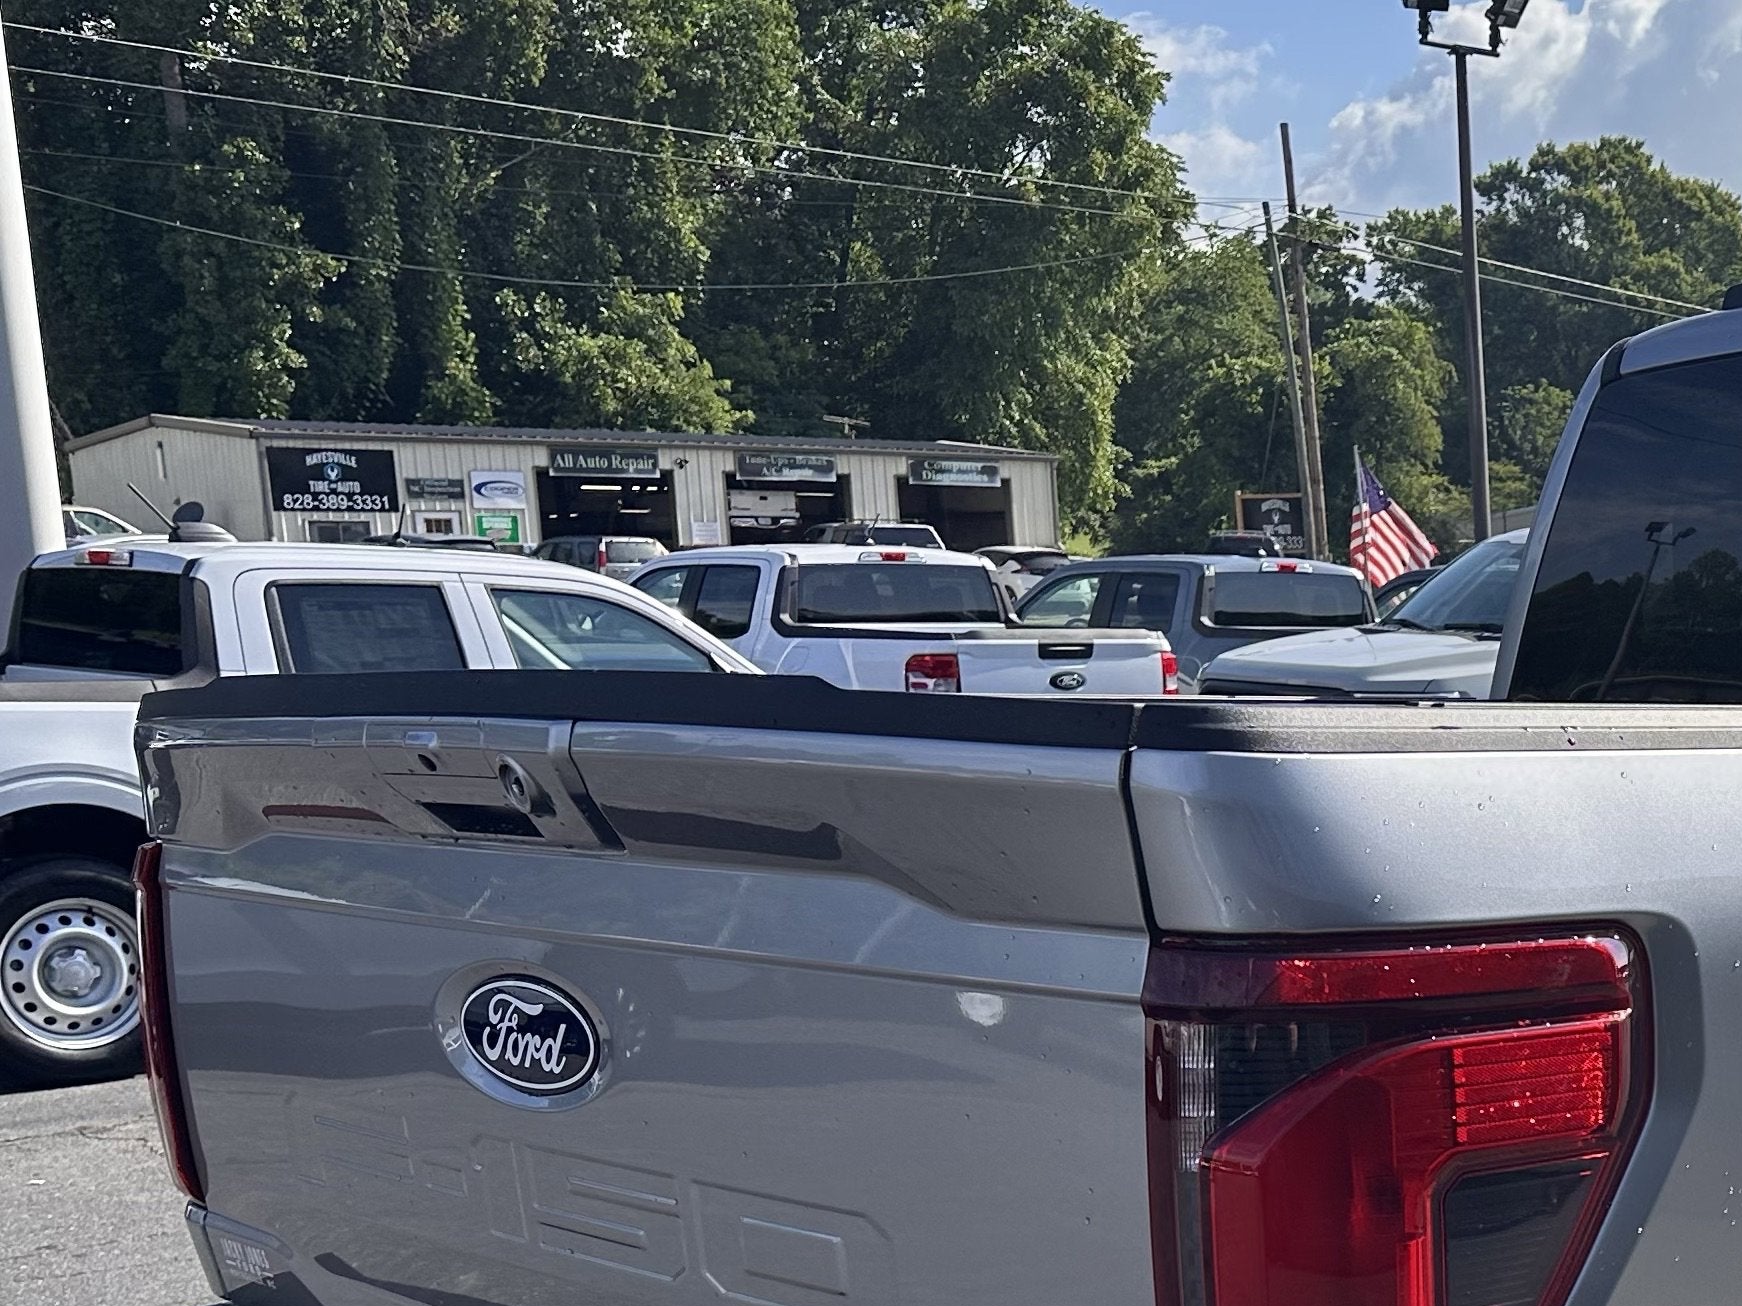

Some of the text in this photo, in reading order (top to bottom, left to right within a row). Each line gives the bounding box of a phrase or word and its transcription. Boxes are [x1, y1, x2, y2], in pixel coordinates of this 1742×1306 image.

[554, 453, 655, 473] All Auto Repair
[283, 493, 389, 510] 828-389-3331
[482, 993, 567, 1074] Ford
